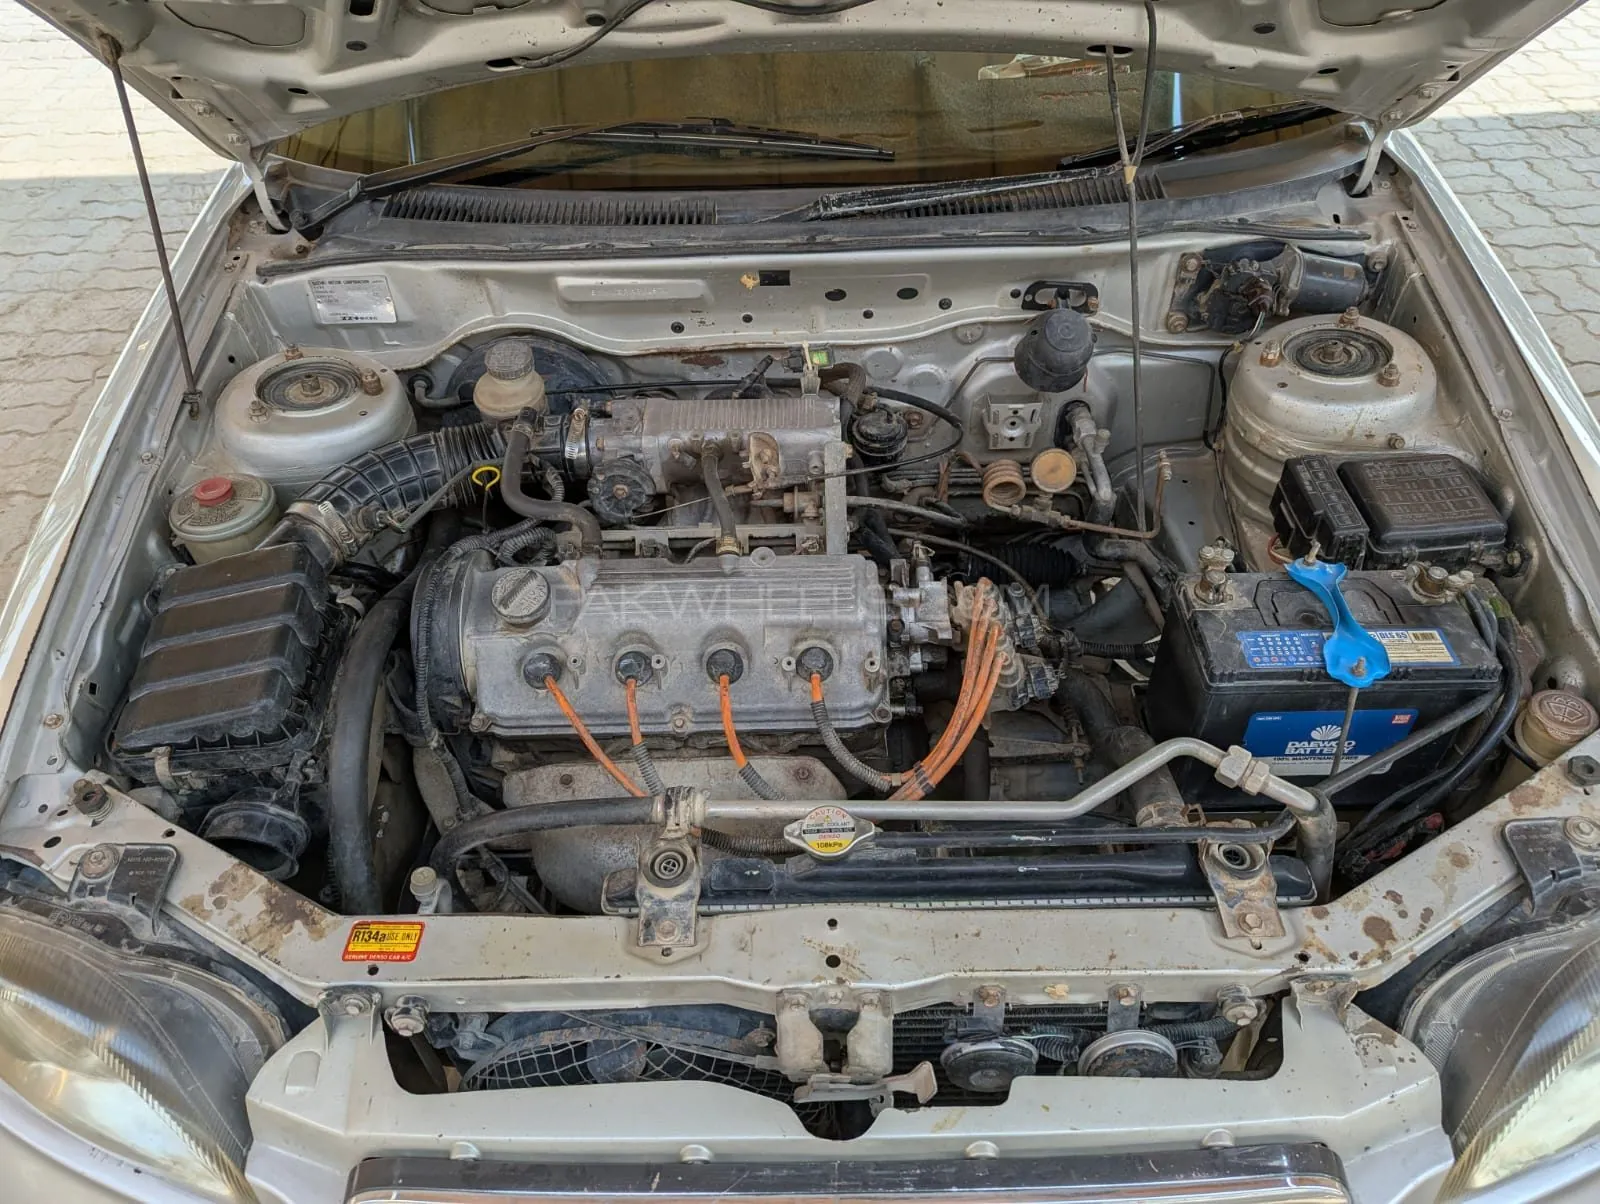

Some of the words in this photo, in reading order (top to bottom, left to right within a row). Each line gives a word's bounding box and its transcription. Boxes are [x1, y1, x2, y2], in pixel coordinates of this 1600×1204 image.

[809, 808, 847, 820] CAUTION
[352, 930, 386, 942] R134a
[386, 932, 400, 941] USE
[401, 932, 418, 941] ONLY
